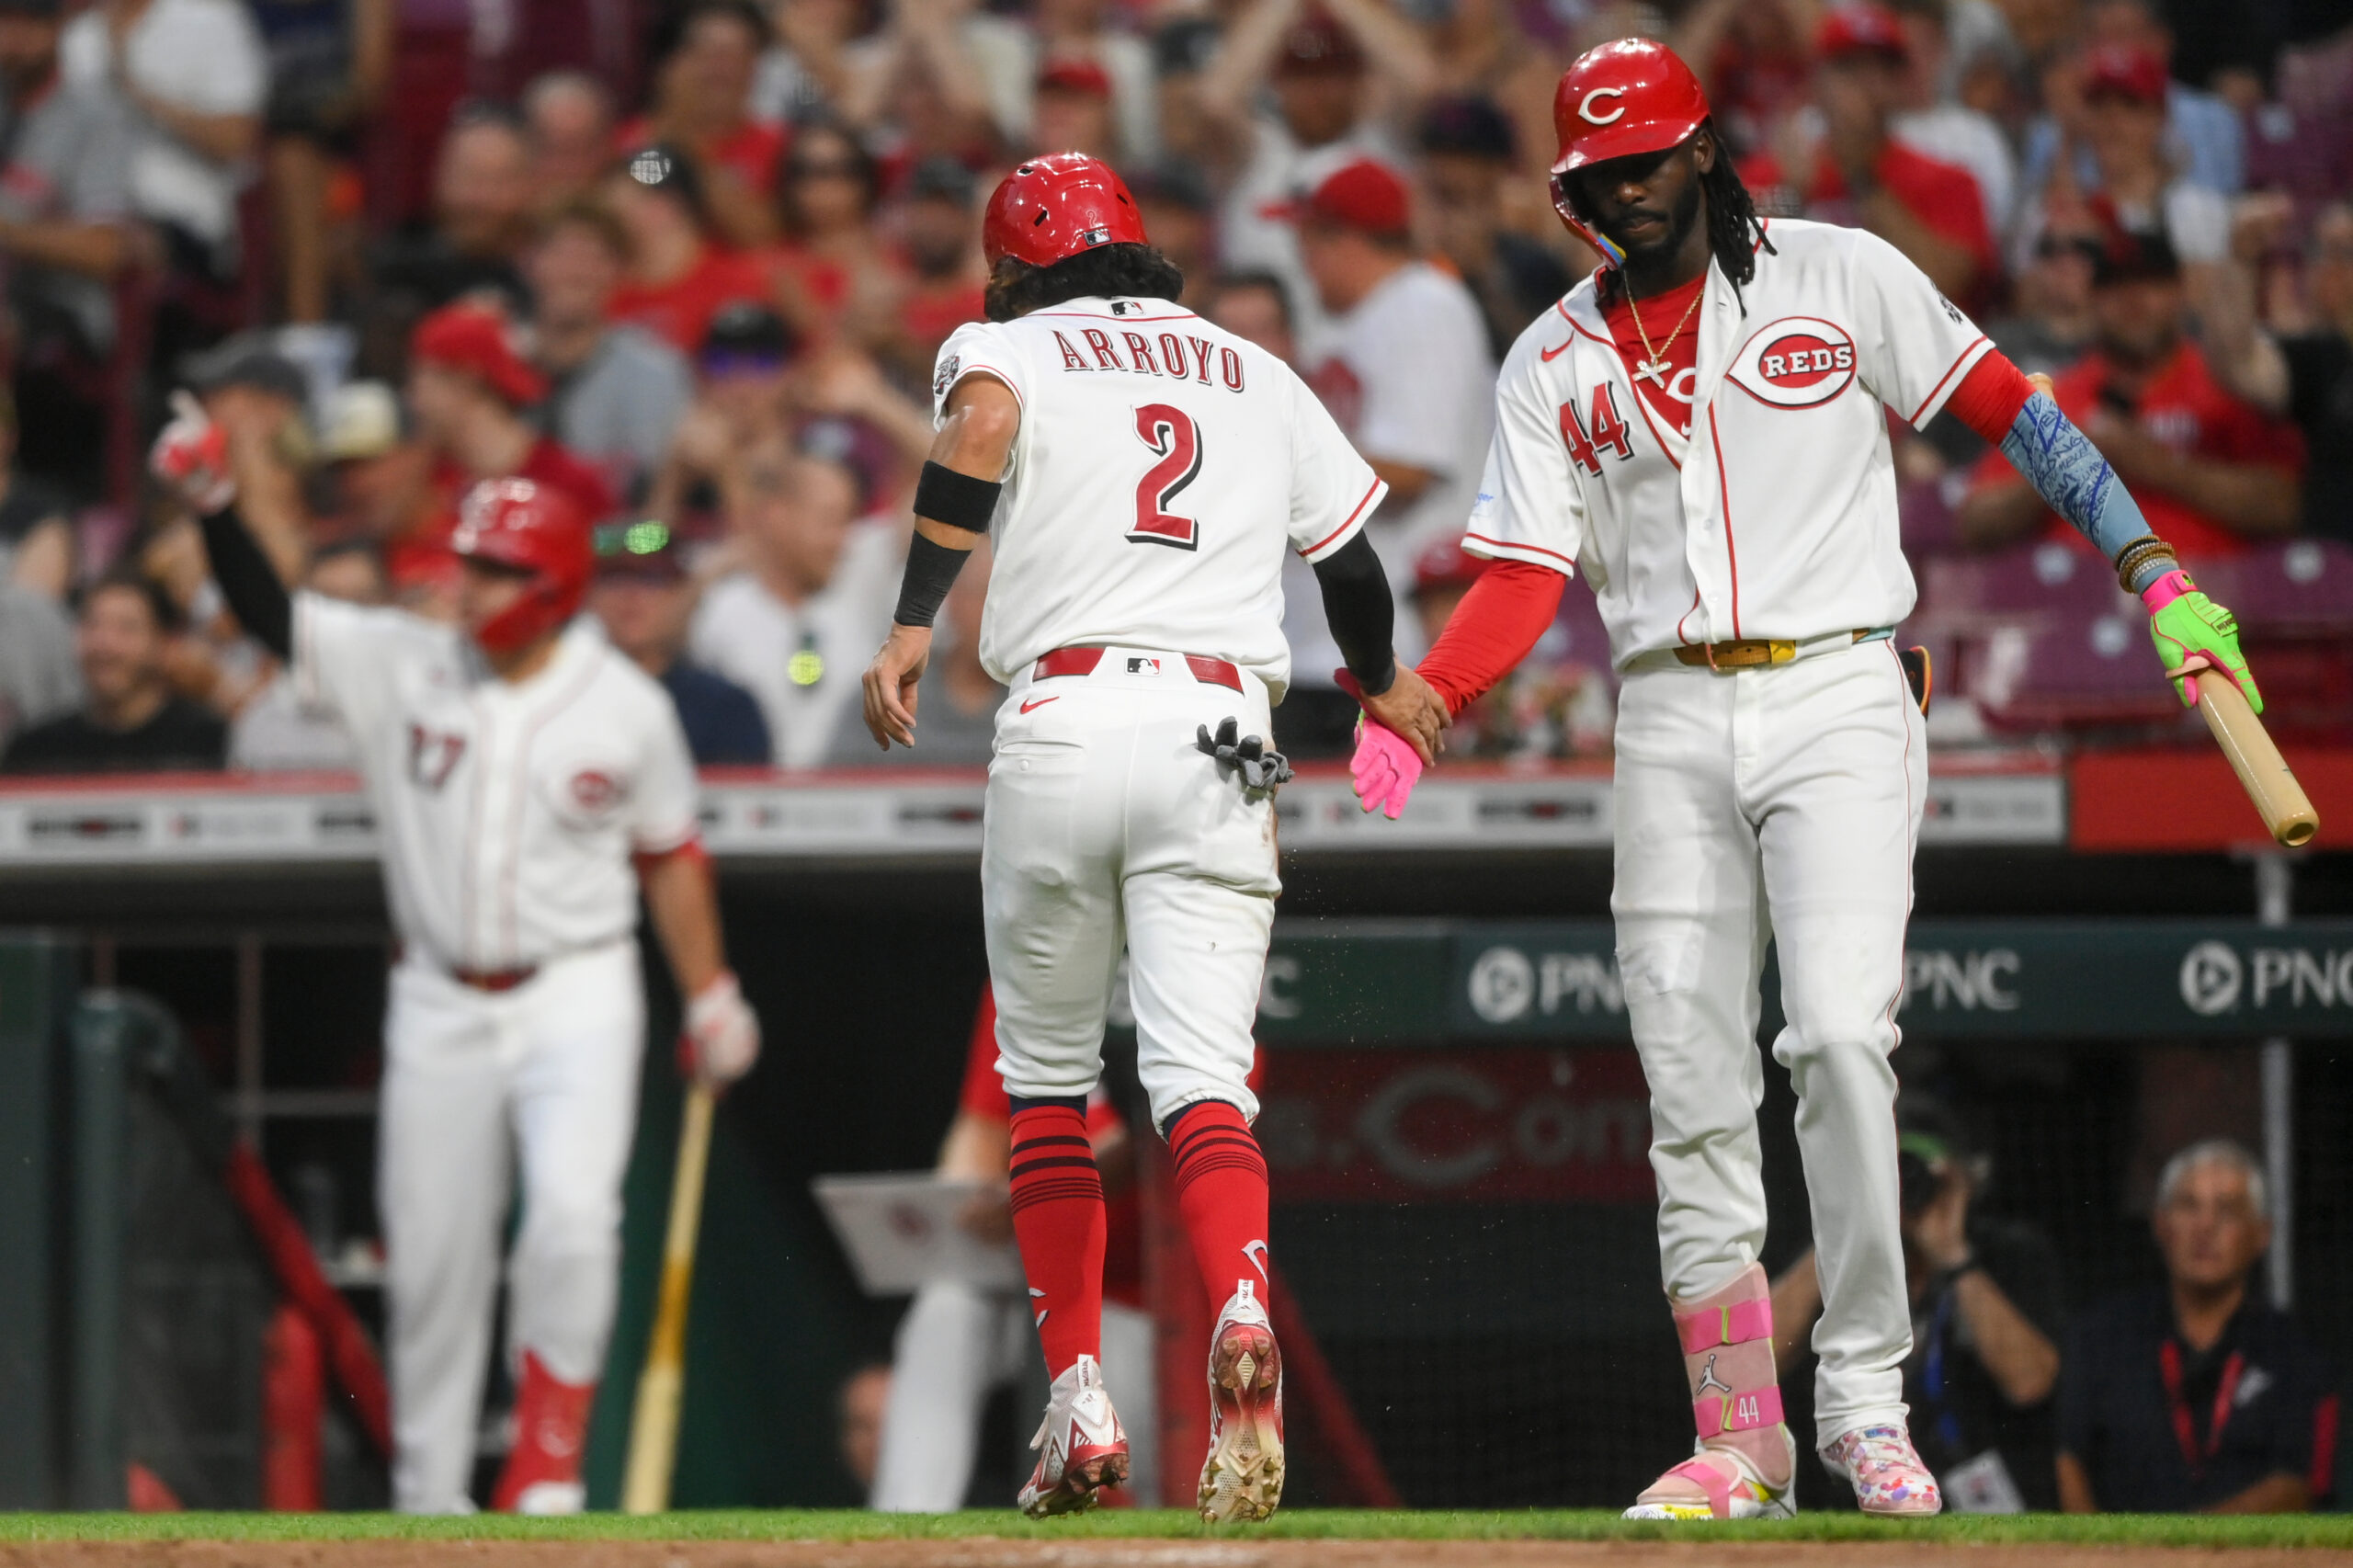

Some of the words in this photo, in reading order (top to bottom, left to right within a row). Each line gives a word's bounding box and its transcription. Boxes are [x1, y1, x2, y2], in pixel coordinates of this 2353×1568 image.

[1578, 87, 1625, 125] C
[1051, 328, 1245, 393] ARROYO
[1763, 347, 1854, 380] REDS
[1559, 381, 1635, 478] 44
[1124, 403, 1203, 551] 2
[1540, 953, 1627, 1015] PN
[1903, 950, 2020, 1011] PNC
[1739, 1395, 1759, 1425] 44
